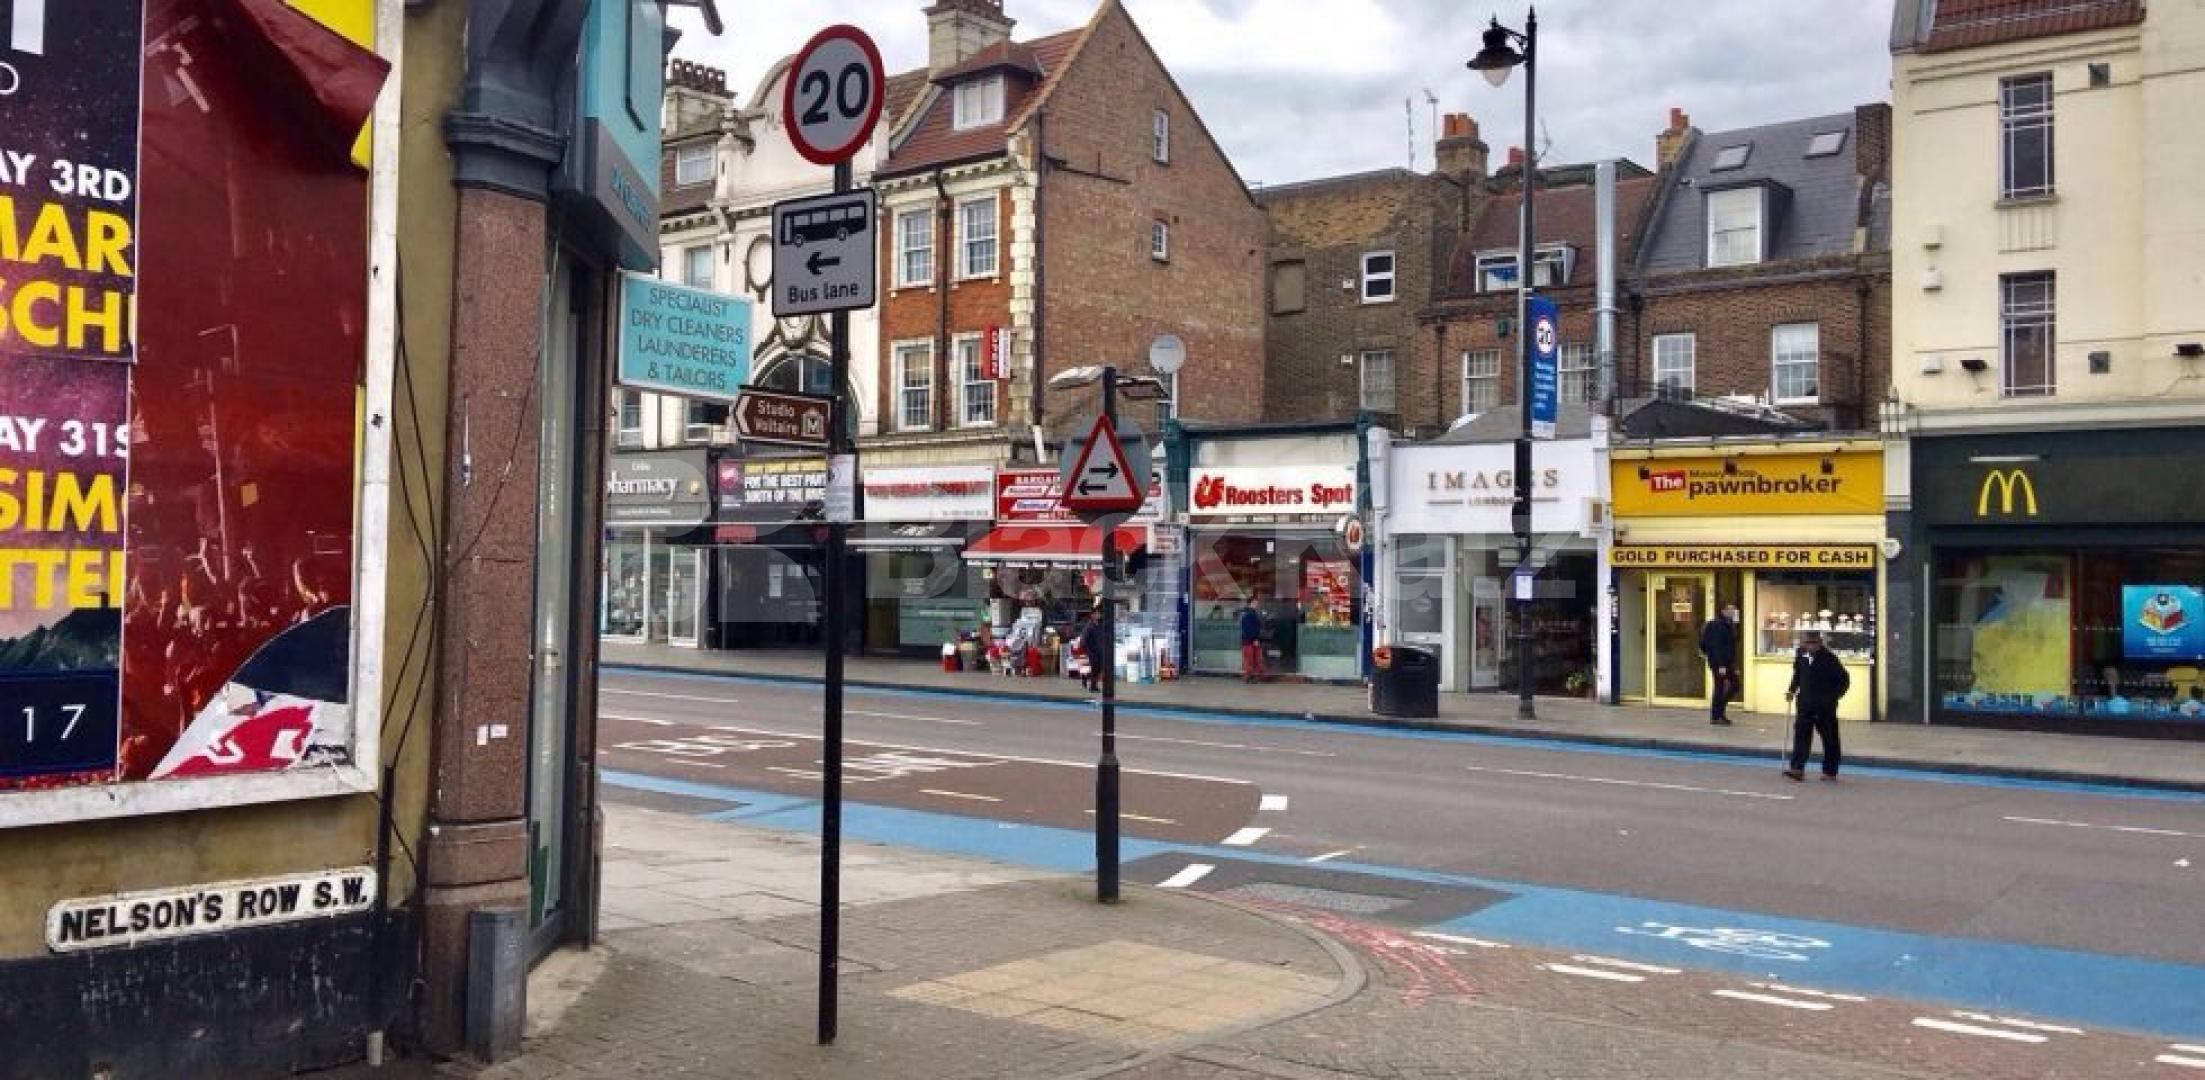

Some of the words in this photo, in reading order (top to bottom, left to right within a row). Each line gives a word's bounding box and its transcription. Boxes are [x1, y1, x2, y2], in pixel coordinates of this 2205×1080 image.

[800, 62, 870, 126] 20
[50, 159, 131, 201] 3RD
[649, 288, 729, 317] SPECIALIST
[788, 287, 819, 304] Bus
[823, 281, 858, 300] lane
[631, 308, 662, 329] DRY
[667, 317, 744, 344] CLEANERS
[638, 336, 737, 367] LAUNDERERS
[648, 362, 662, 380] &
[664, 364, 725, 389] TAILORS
[757, 399, 795, 417] Studio
[755, 415, 800, 435] Voltaire
[1427, 469, 1559, 490] IMAGS
[1653, 476, 1683, 490] The
[1689, 474, 1842, 499] pawnbroker
[1226, 485, 1304, 506] Roosters
[1312, 482, 1353, 509] Spot
[1614, 550, 1658, 564] GOLD
[1665, 550, 1769, 564] PURCHASED
[1775, 550, 1811, 564] FOR
[1817, 550, 1869, 564] CASH
[58, 892, 224, 941] NELSON'S
[237, 883, 301, 919] ROW
[313, 877, 368, 908] S.W.
